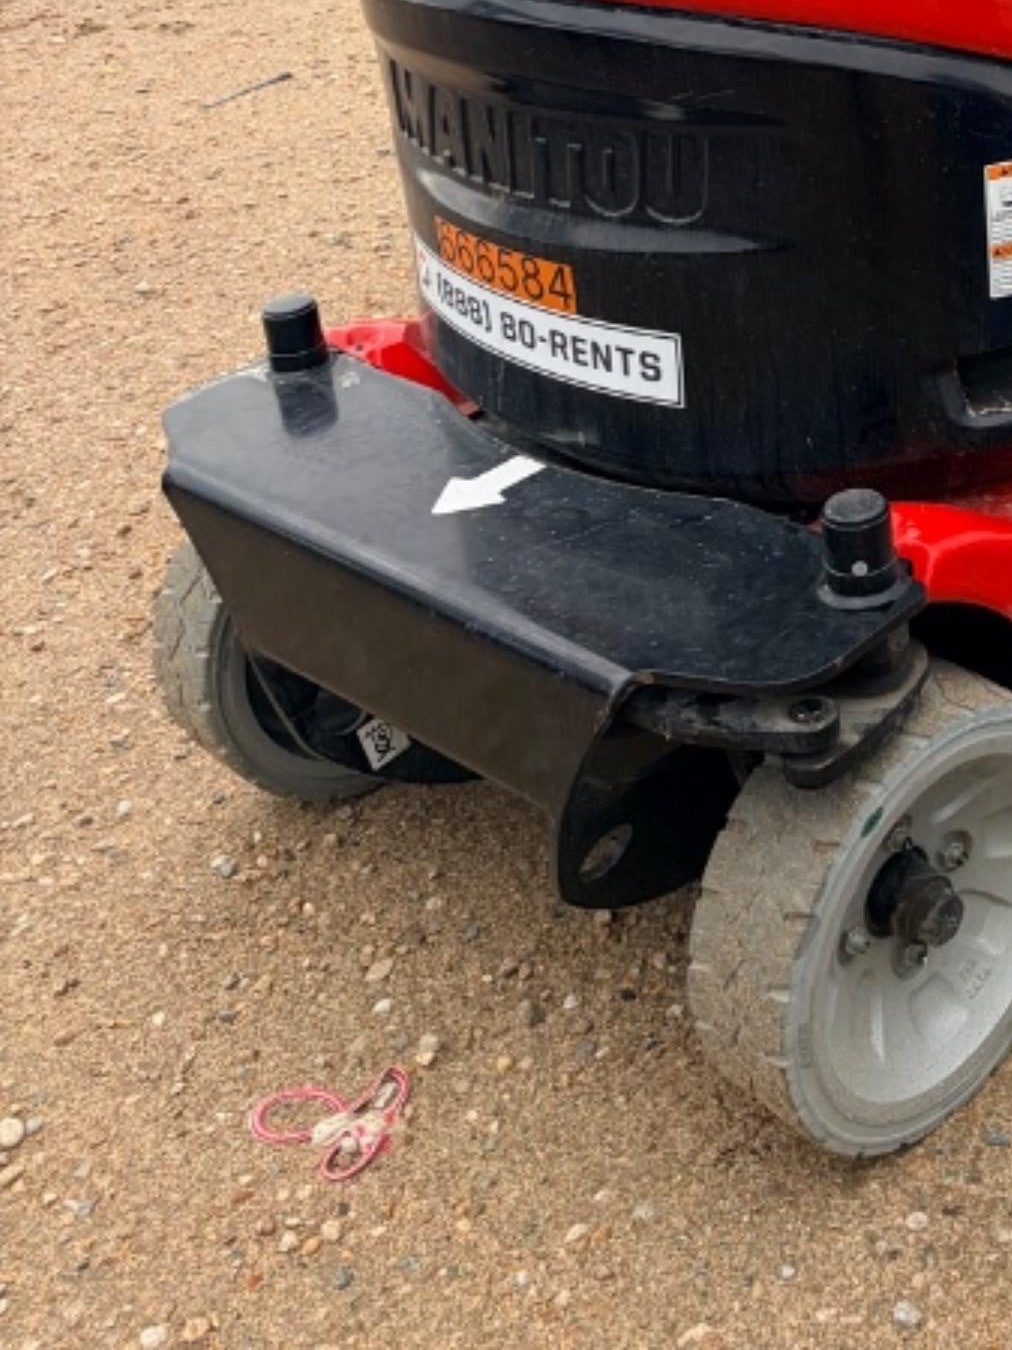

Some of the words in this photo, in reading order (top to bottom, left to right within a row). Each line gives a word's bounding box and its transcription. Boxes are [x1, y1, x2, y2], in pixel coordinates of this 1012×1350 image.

[389, 58, 709, 225] MANITOU
[437, 272, 492, 332] (888)
[440, 222, 573, 309] 666584
